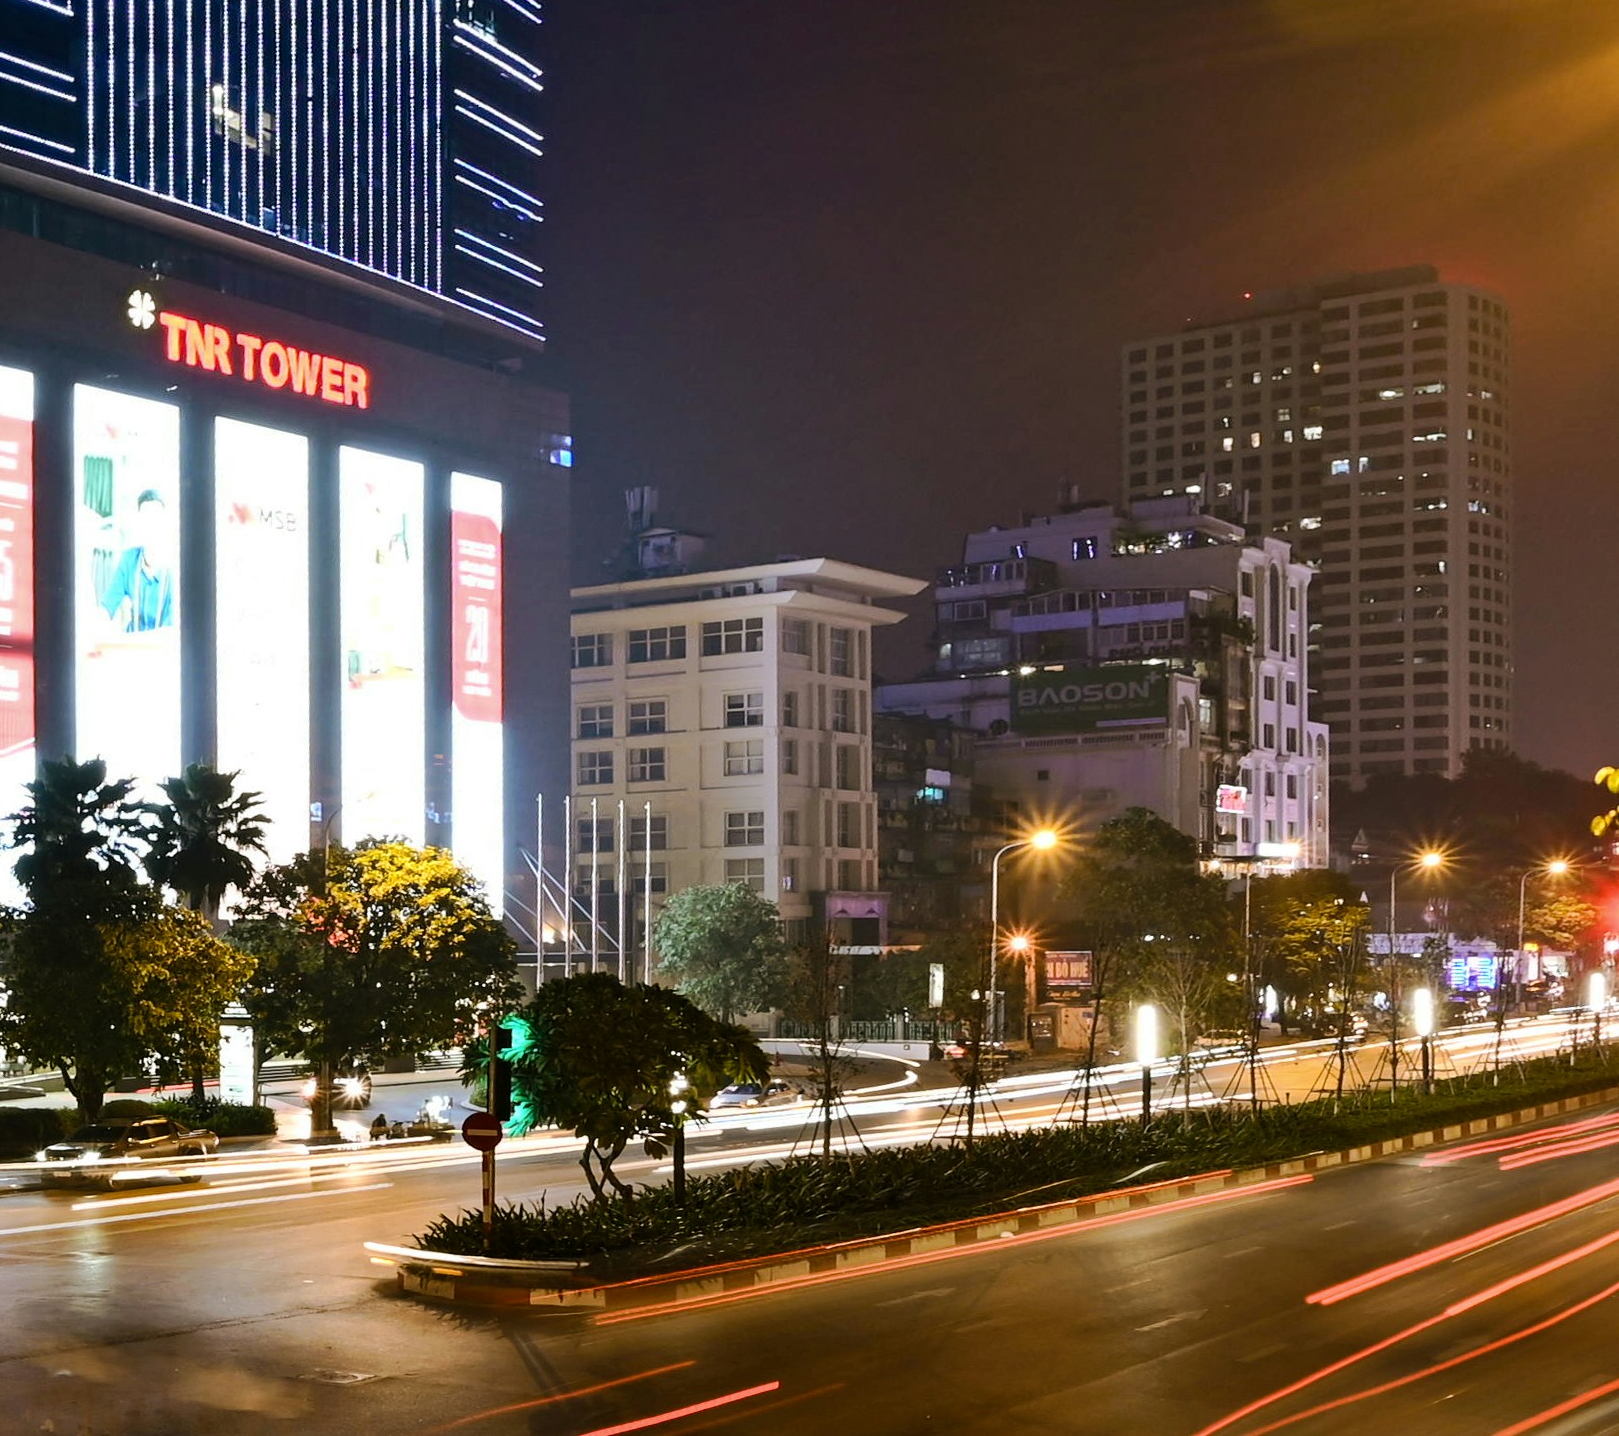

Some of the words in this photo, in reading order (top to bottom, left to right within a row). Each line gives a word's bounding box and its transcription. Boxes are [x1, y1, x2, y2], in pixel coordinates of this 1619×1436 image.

[160, 313, 233, 376] TNR
[237, 333, 370, 410] TOWER
[258, 508, 298, 533] MSB
